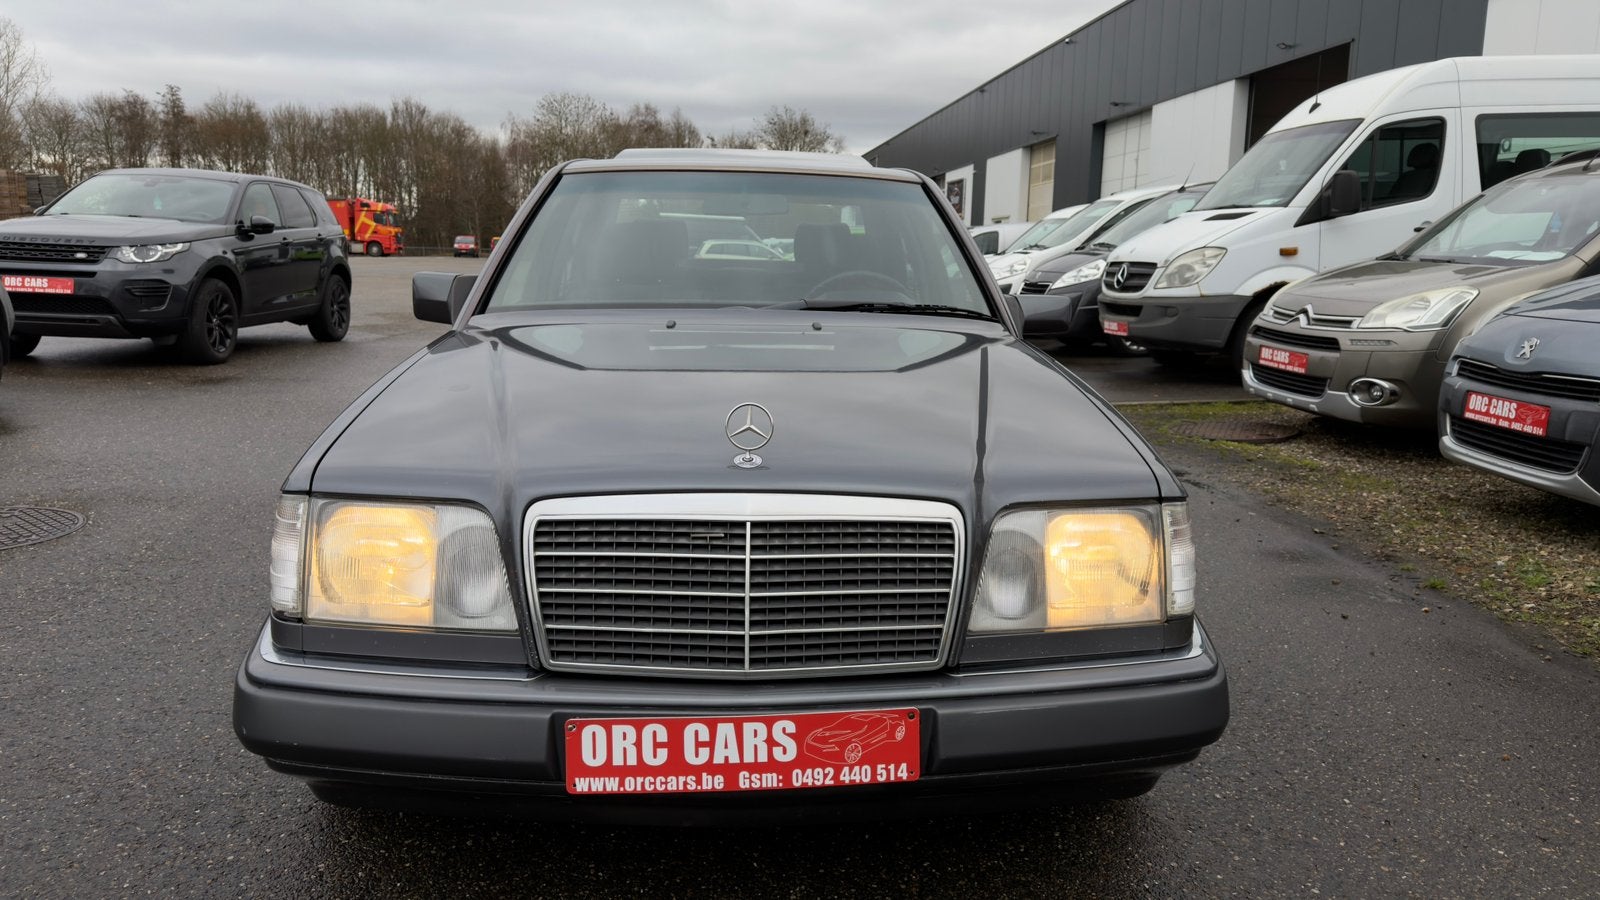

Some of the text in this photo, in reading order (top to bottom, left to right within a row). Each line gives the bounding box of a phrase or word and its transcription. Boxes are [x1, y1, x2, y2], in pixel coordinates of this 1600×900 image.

[3, 235, 96, 244] DISCOVERY
[4, 276, 49, 288] ORC CARS
[1469, 394, 1517, 419] ORC CARS
[581, 719, 798, 767] ORC CARS
[575, 762, 908, 792] www.orccars.be Gsm: 0492 440 514
